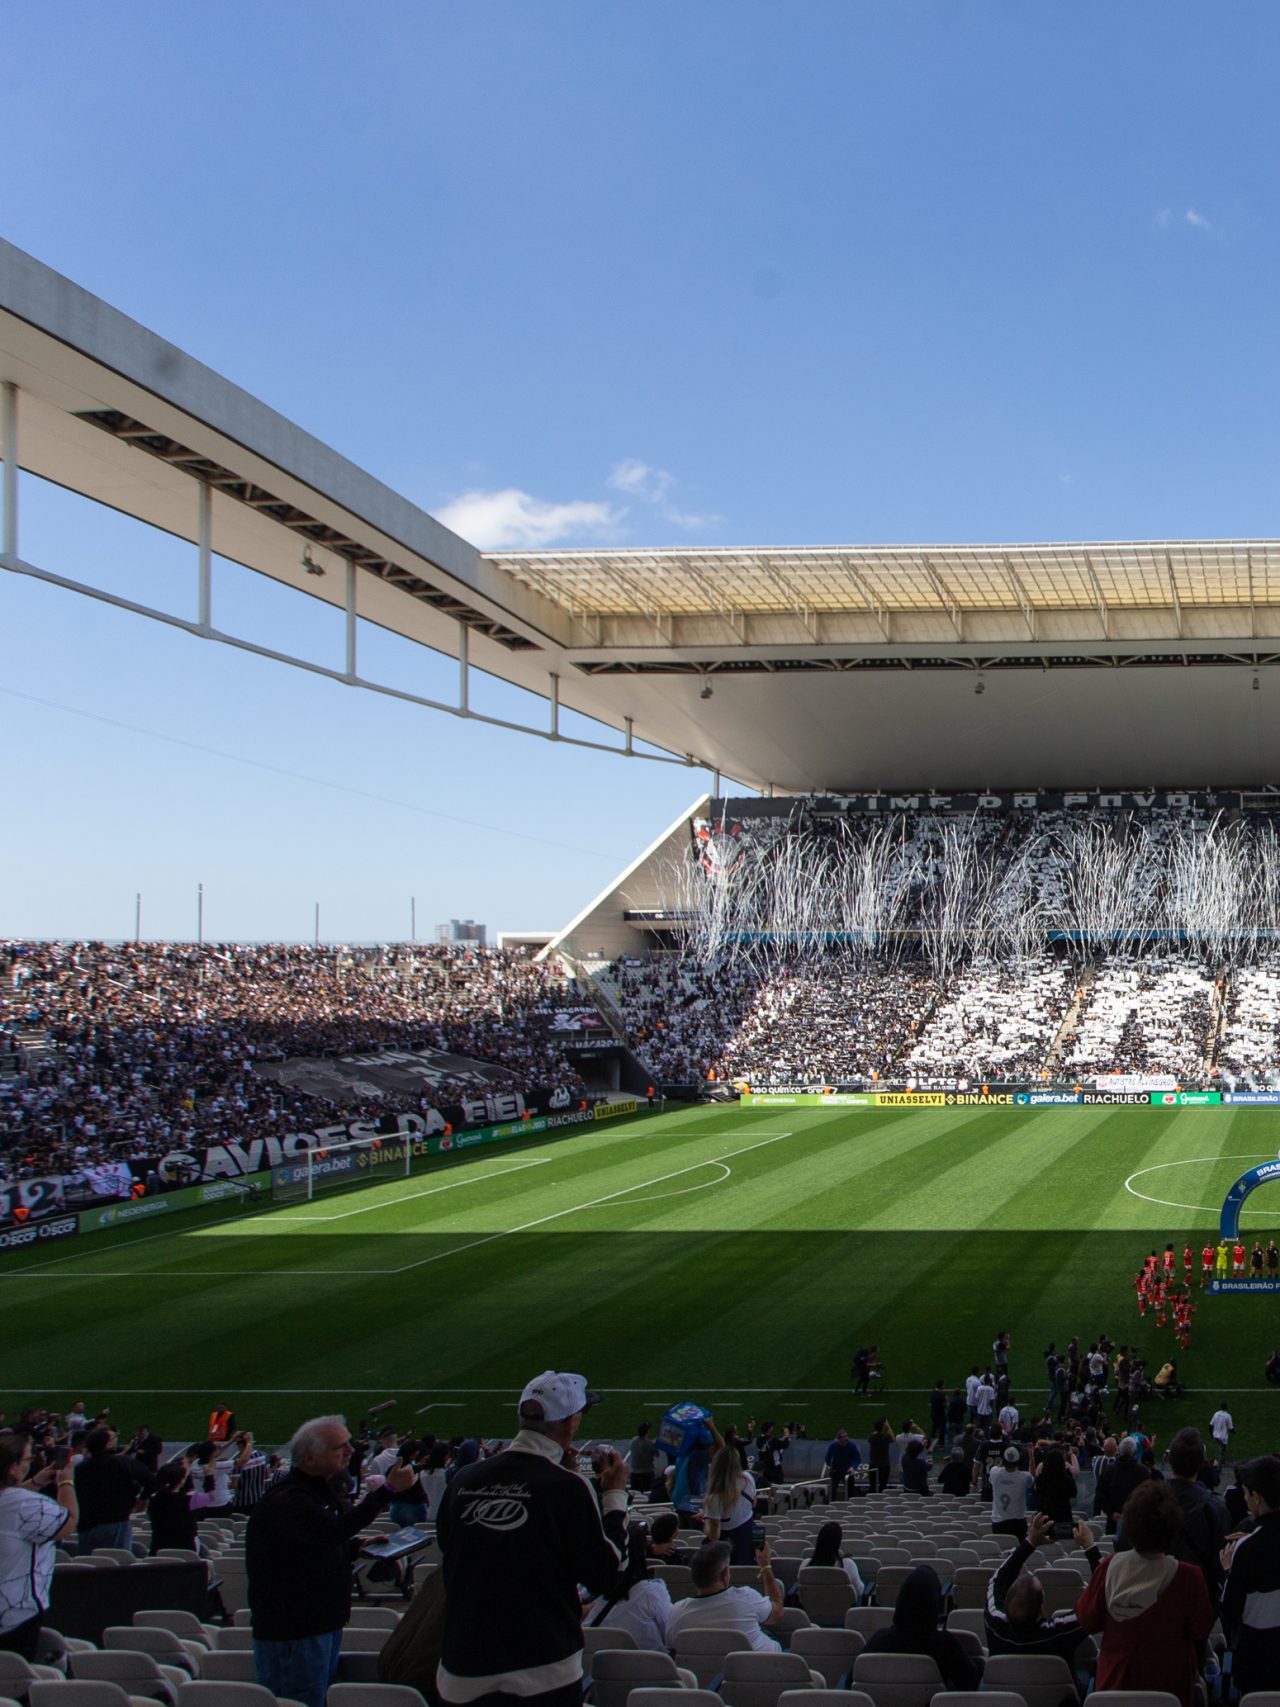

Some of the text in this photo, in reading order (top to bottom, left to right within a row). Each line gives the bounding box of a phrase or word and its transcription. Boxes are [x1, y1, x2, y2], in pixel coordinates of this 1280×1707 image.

[833, 795, 1190, 810] TIME DO POVO
[919, 1077, 957, 1086] LPTC
[880, 1095, 943, 1105] UNIASSELVI
[956, 1094, 1013, 1105] BINANCE
[1030, 1093, 1079, 1105] galera.bet
[1083, 1094, 1149, 1105] RIACHUELO
[597, 1101, 636, 1119] UNIASSELVI
[397, 1108, 447, 1140] DA
[546, 1109, 594, 1129] RIACHUELO
[51, 1220, 77, 1238] SCCP
[9, 1229, 37, 1247] SCCP
[1221, 1281, 1274, 1291] BRASILEIRÃO
[1001, 1494, 1011, 1511] 9
